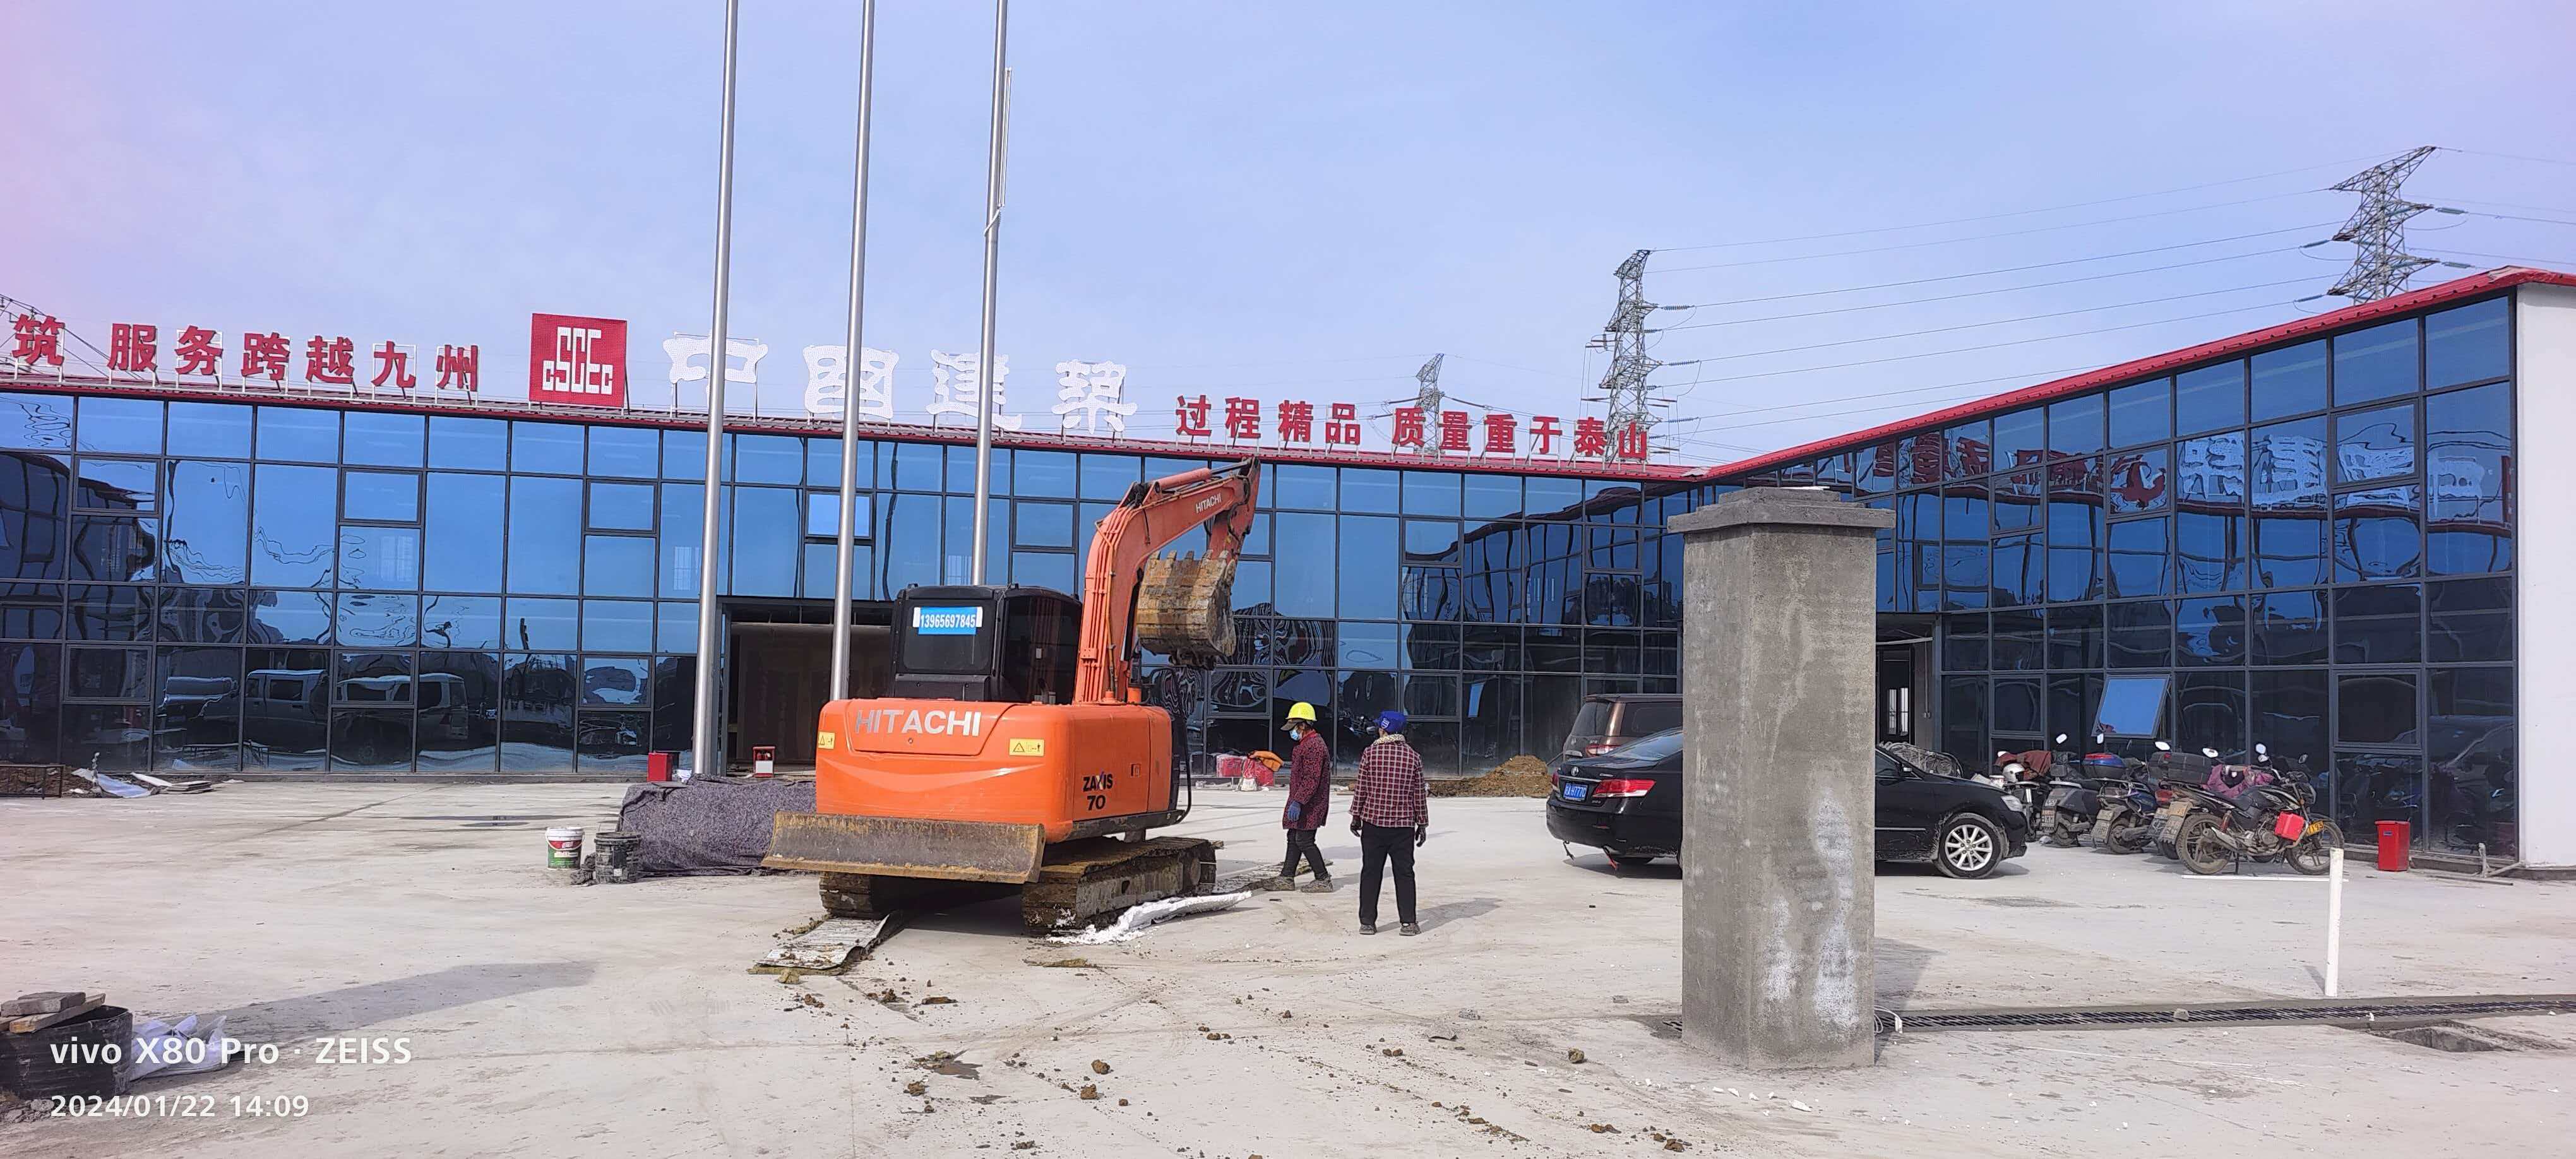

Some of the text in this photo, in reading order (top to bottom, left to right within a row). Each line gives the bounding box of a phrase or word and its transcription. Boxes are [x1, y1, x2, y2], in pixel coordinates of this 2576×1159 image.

[11, 314, 479, 392] 筑 服务跨越九州
[1175, 395, 1648, 461] 过程精品 质量重于泰山
[1195, 492, 1222, 514] HITACHI
[920, 614, 976, 629] 13965697845
[854, 709, 982, 737] HITACHI
[1083, 771, 1113, 793] ZAXIS
[1087, 795, 1106, 811] 70
